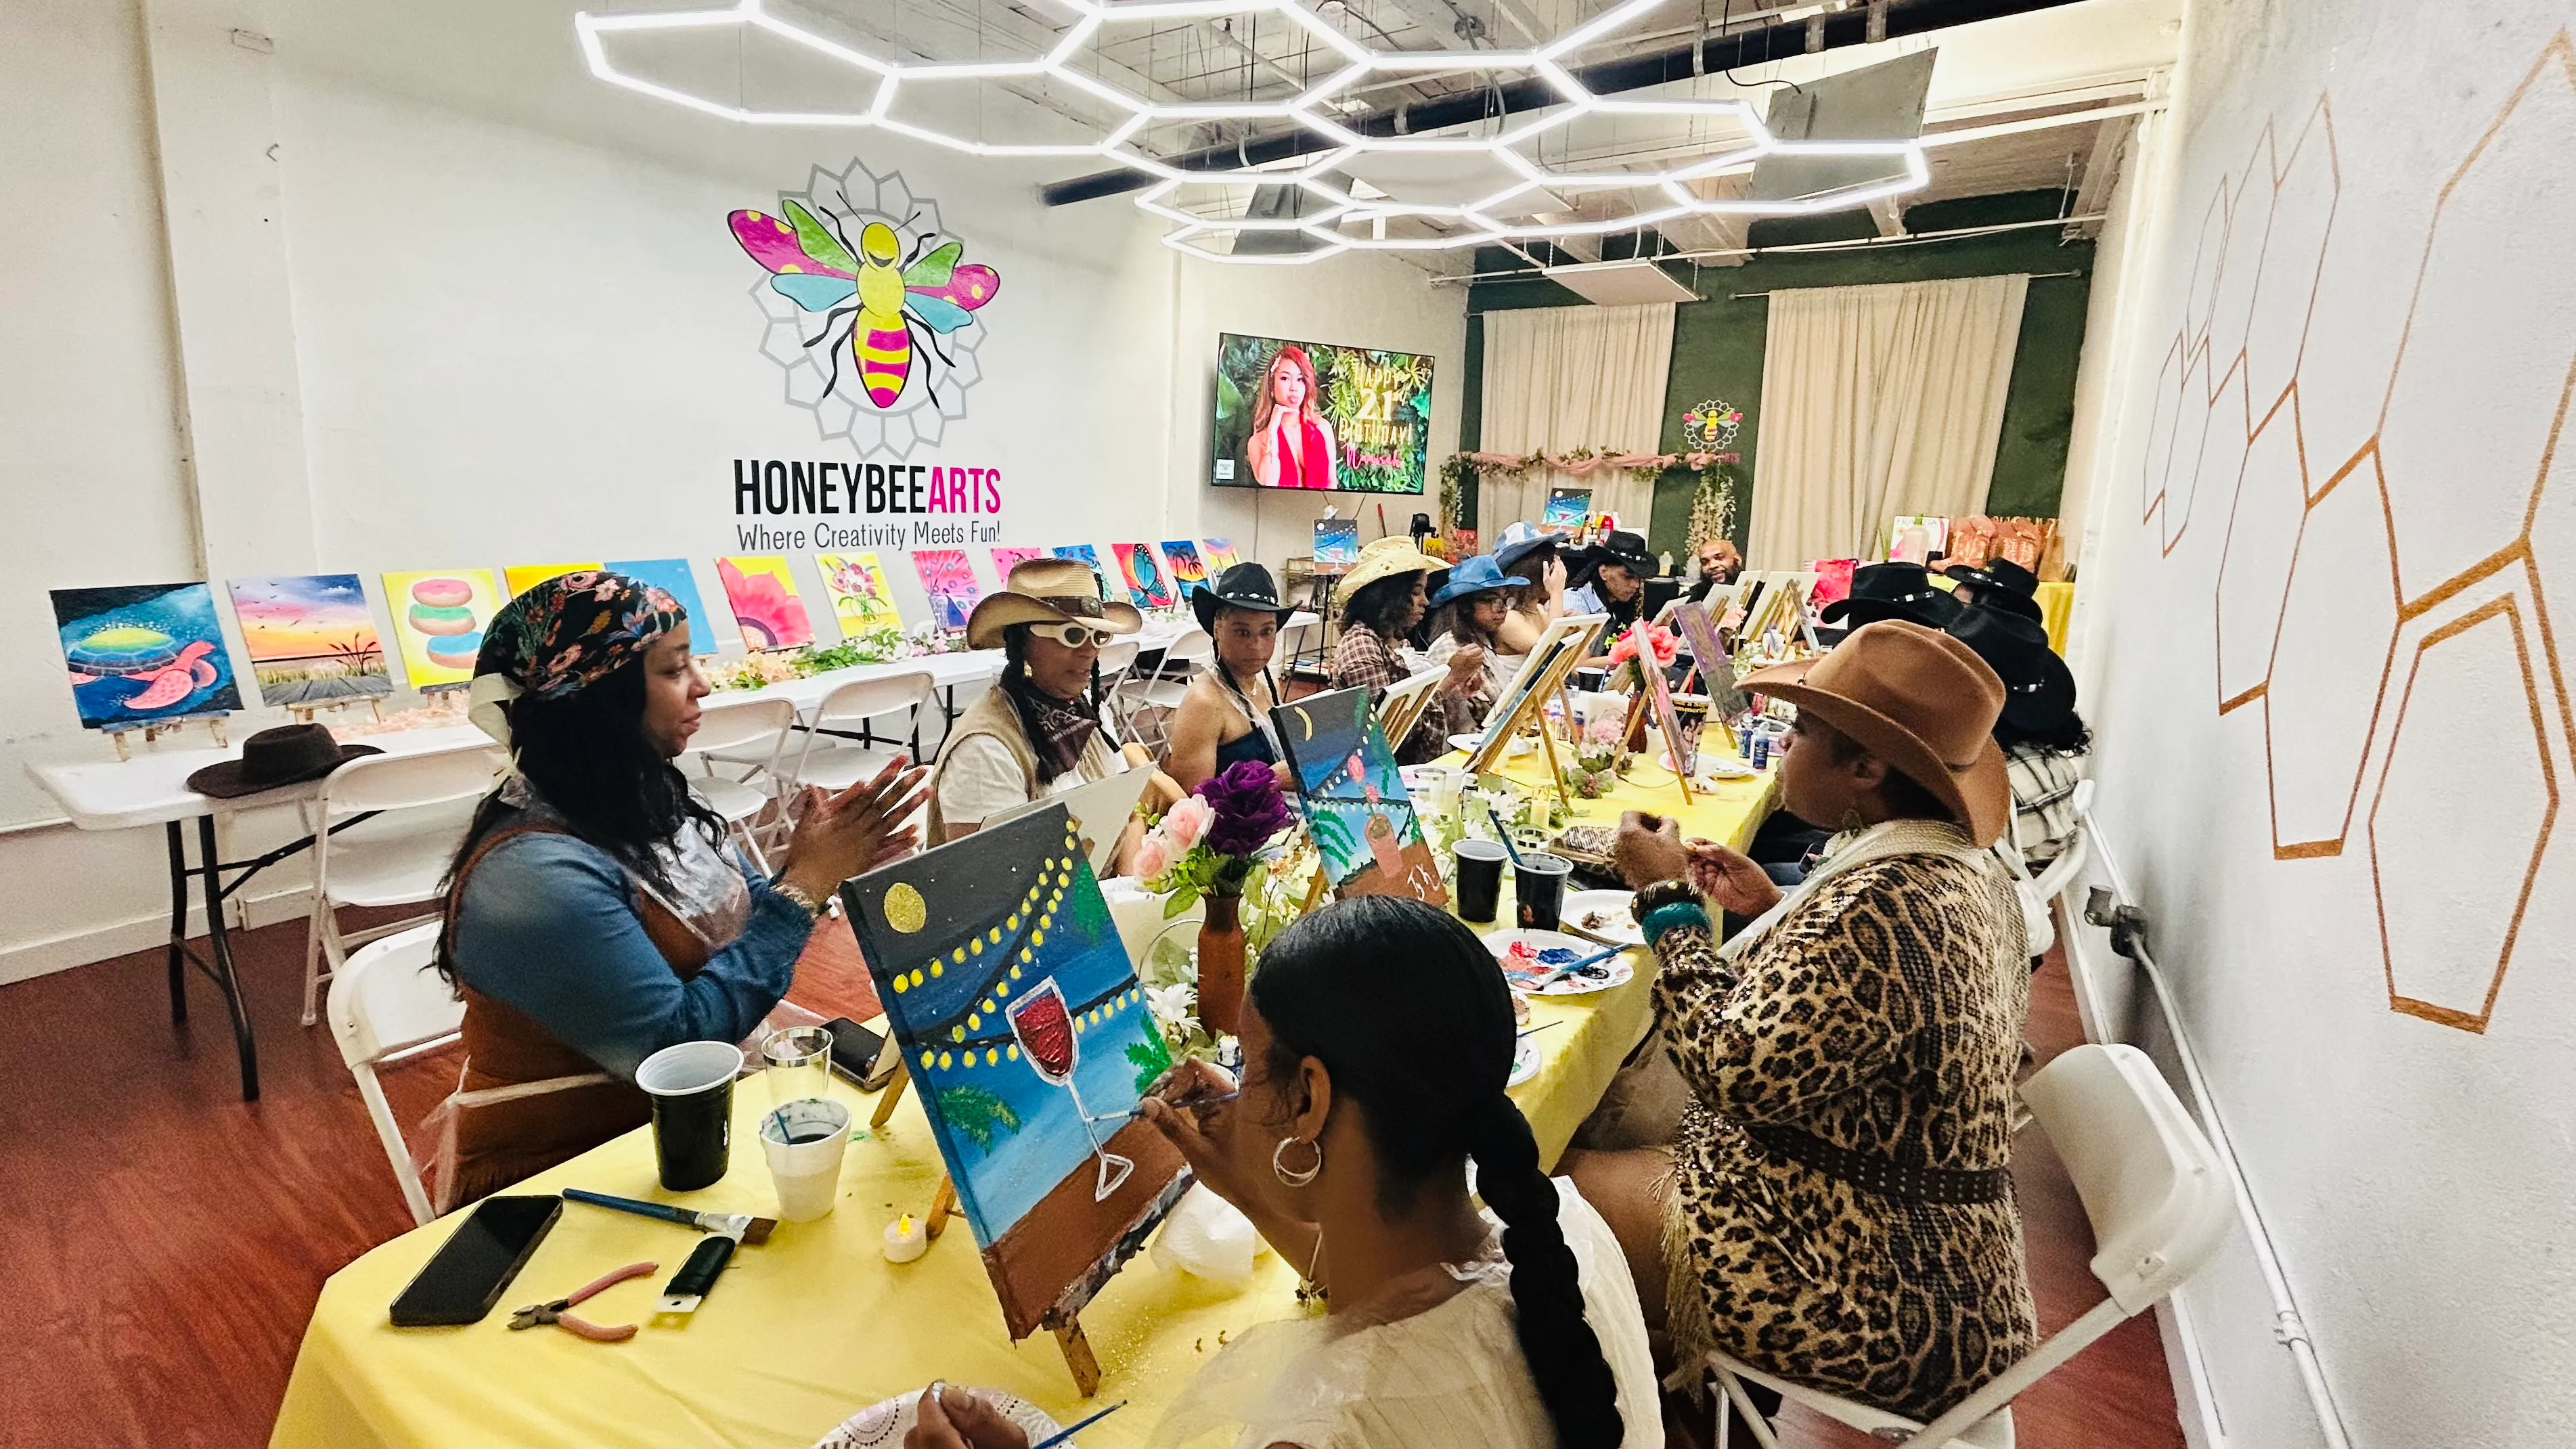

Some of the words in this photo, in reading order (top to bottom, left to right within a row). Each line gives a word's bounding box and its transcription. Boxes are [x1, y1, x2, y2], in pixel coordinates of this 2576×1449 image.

[1354, 361, 1404, 389] HAPPY
[1338, 417, 1413, 446] BIRTHDAY!
[737, 524, 805, 550] Where
[814, 522, 906, 550] Creativity
[914, 521, 964, 544] Meets
[971, 520, 1000, 543] Fun!
[1896, 517, 1937, 527] FRAZIA
